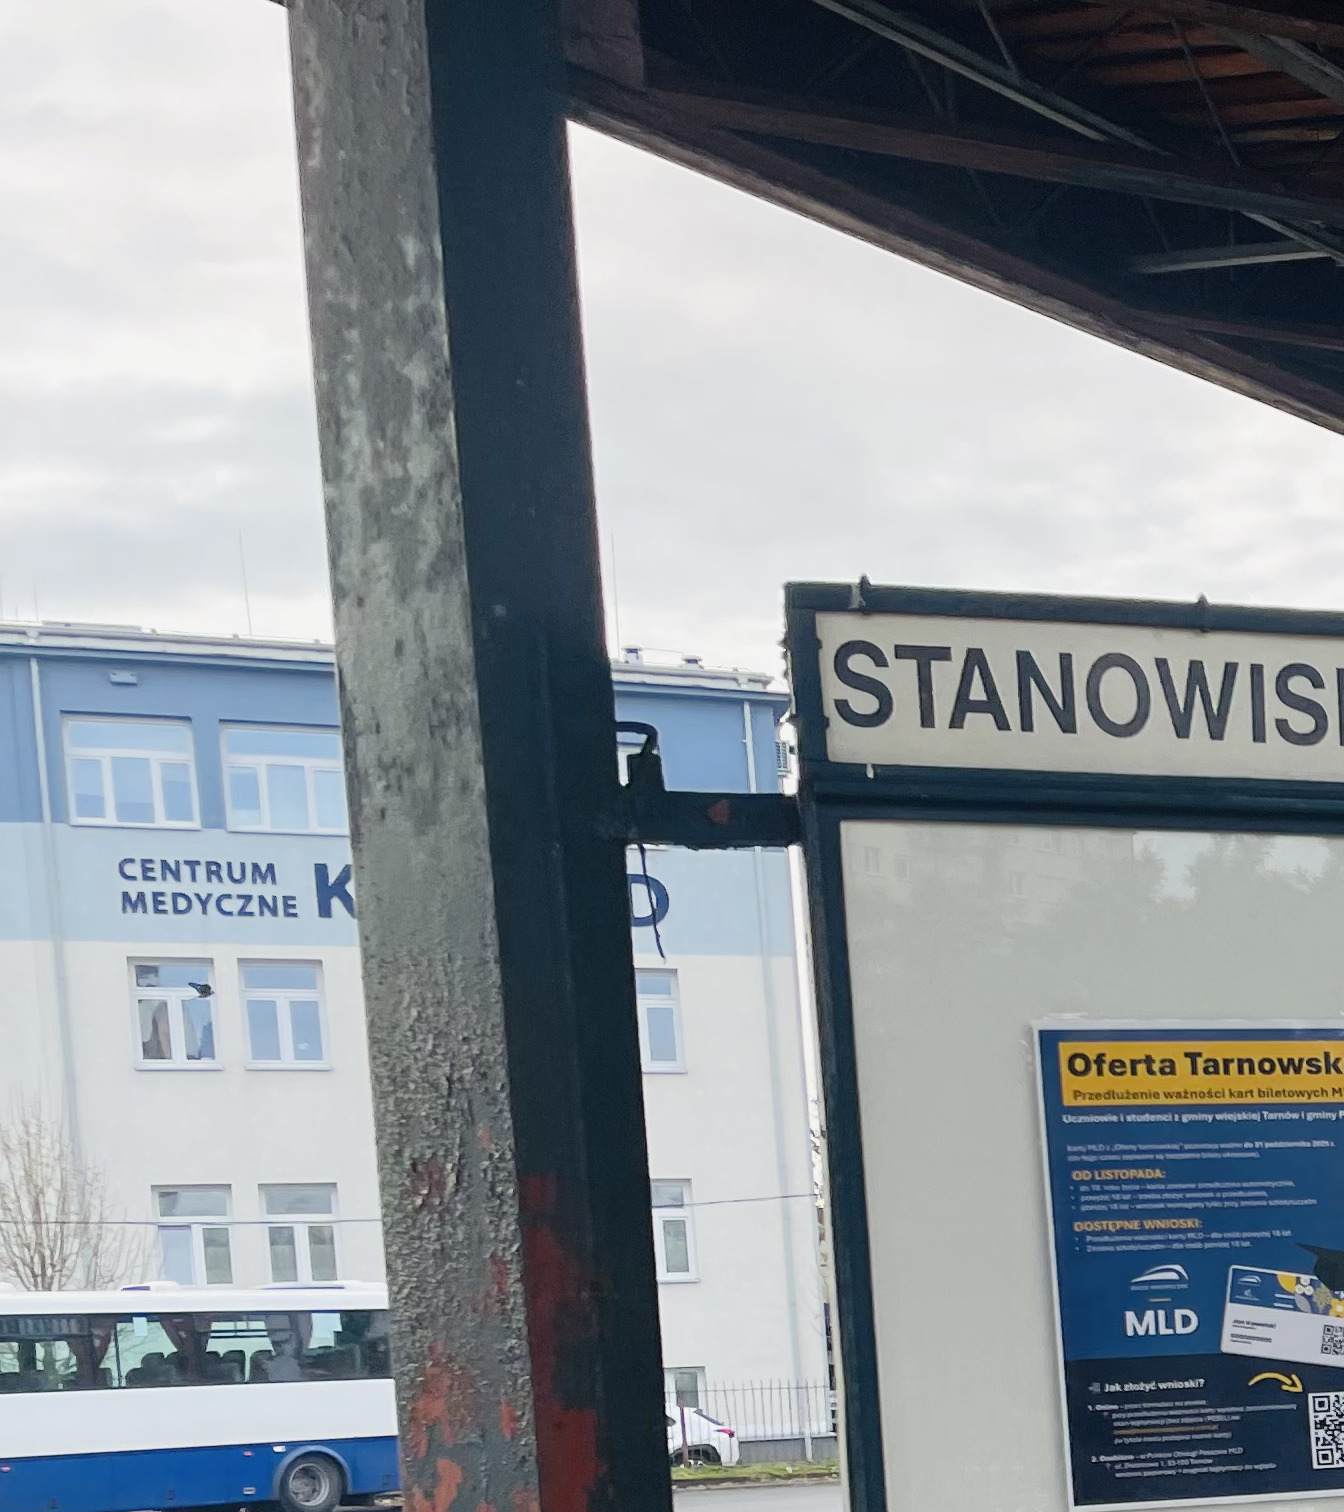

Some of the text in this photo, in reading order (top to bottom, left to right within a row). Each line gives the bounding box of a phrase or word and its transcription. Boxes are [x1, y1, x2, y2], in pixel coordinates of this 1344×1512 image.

[118, 857, 278, 886] CENTRUM
[121, 890, 299, 919] MEDYCZNE
[1067, 1052, 1176, 1077] Oferta
[1073, 1089, 1160, 1101] Przedłużenie
[1164, 1088, 1225, 1099] ważności
[1229, 1088, 1254, 1098] kart
[1258, 1087, 1328, 1100] biletowych
[1126, 1113, 1173, 1122] studenci
[1181, 1112, 1214, 1123] gminy
[1215, 1111, 1260, 1122] wiejskiej
[1262, 1111, 1299, 1121] Tarnów
[1306, 1110, 1338, 1122] gminy
[1072, 1168, 1166, 1180] OD LISTOPADA:
[1124, 1308, 1199, 1336] MLD
[1104, 1382, 1122, 1393] Jak
[1157, 1379, 1205, 1391] wnioski?
